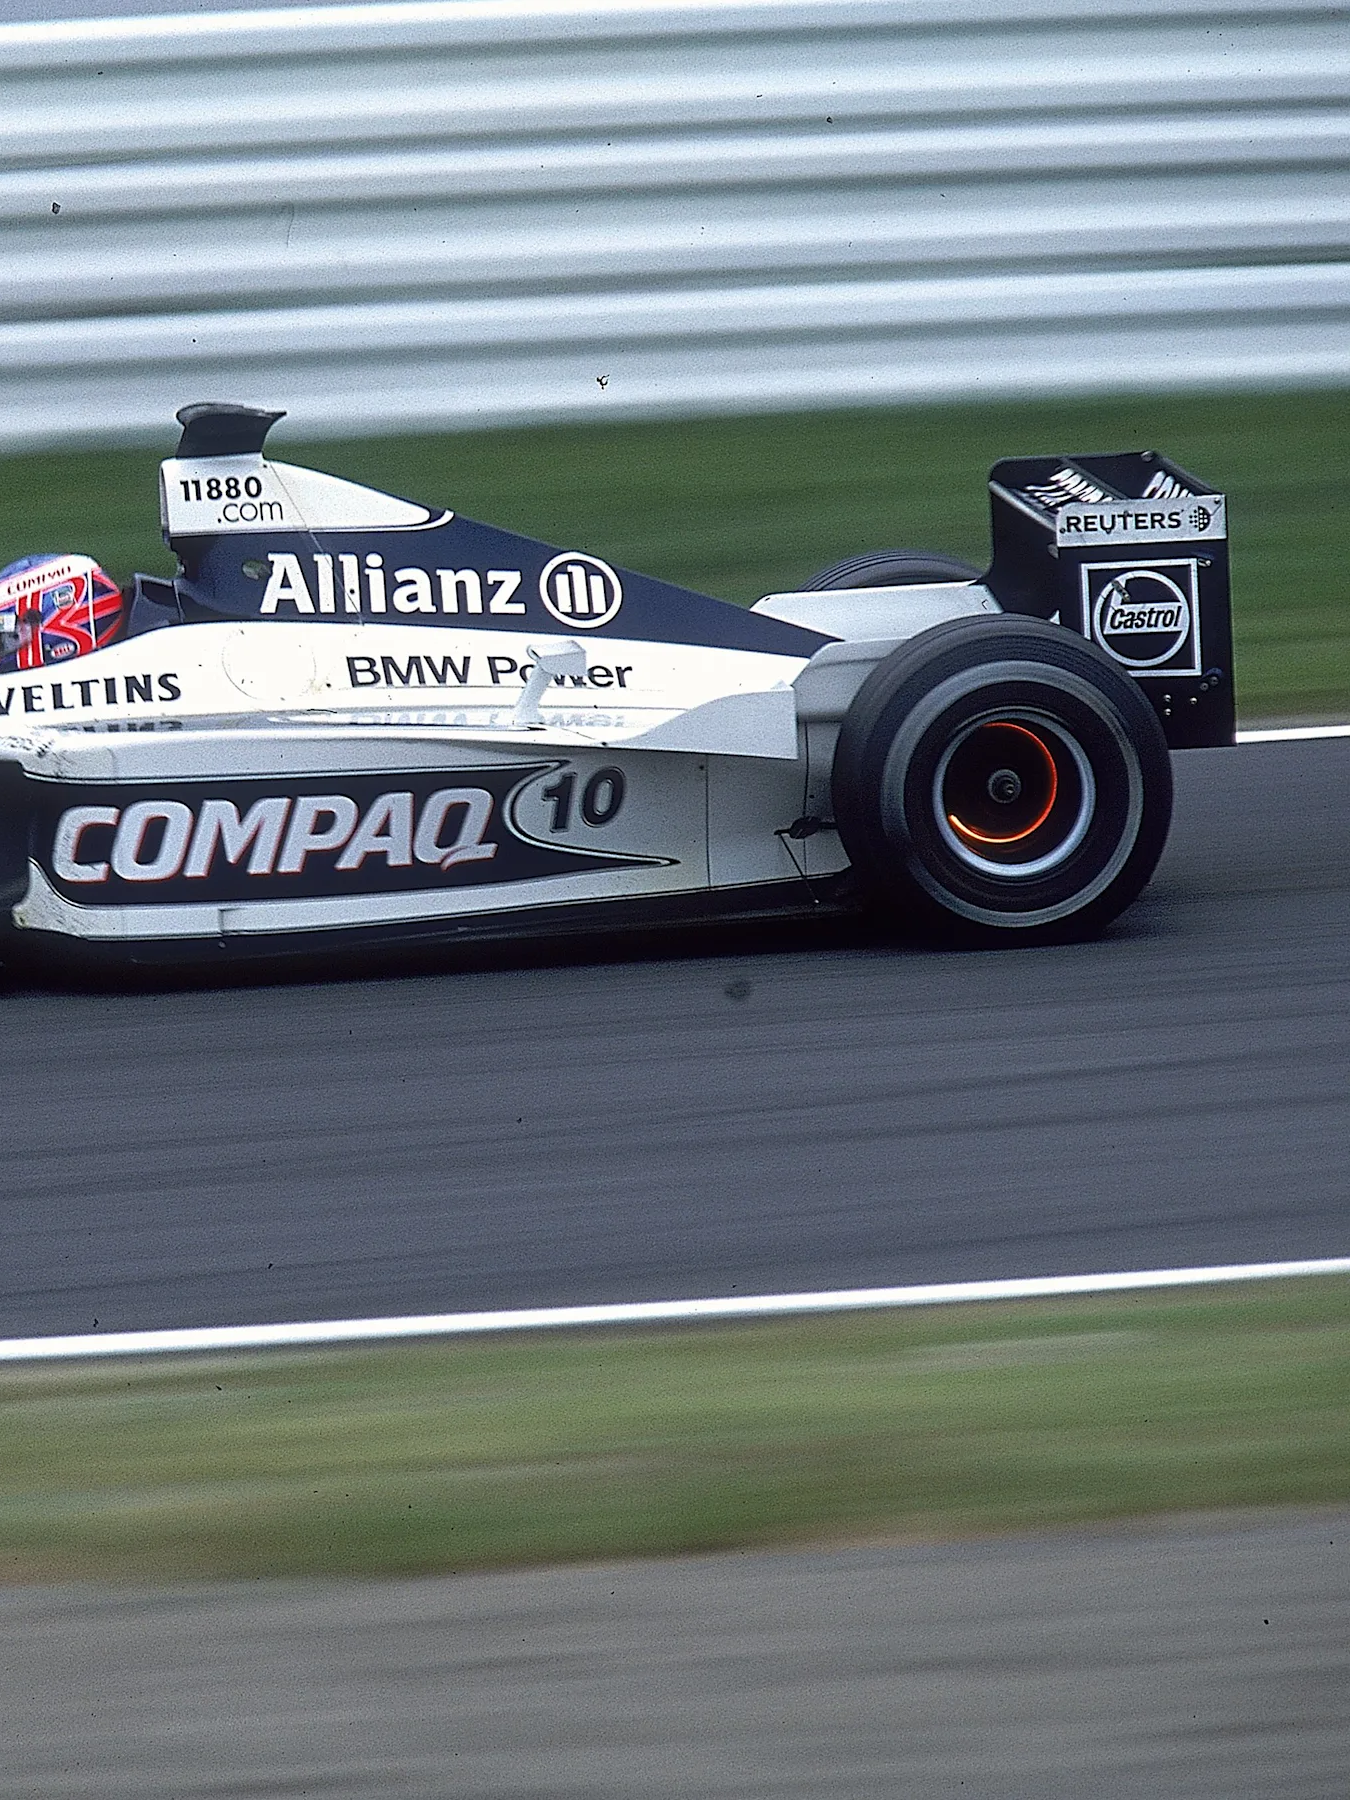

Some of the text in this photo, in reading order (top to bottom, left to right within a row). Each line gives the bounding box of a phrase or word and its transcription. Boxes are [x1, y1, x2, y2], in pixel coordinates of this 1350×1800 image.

[179, 476, 262, 502] 11880
[217, 500, 284, 524] .com
[1065, 511, 1182, 534] REUTERS
[260, 553, 526, 614] Allianz
[1109, 605, 1183, 630] Castrol
[346, 655, 471, 688] BMW
[543, 767, 625, 834] 10
[52, 786, 498, 884] COMPAQ
